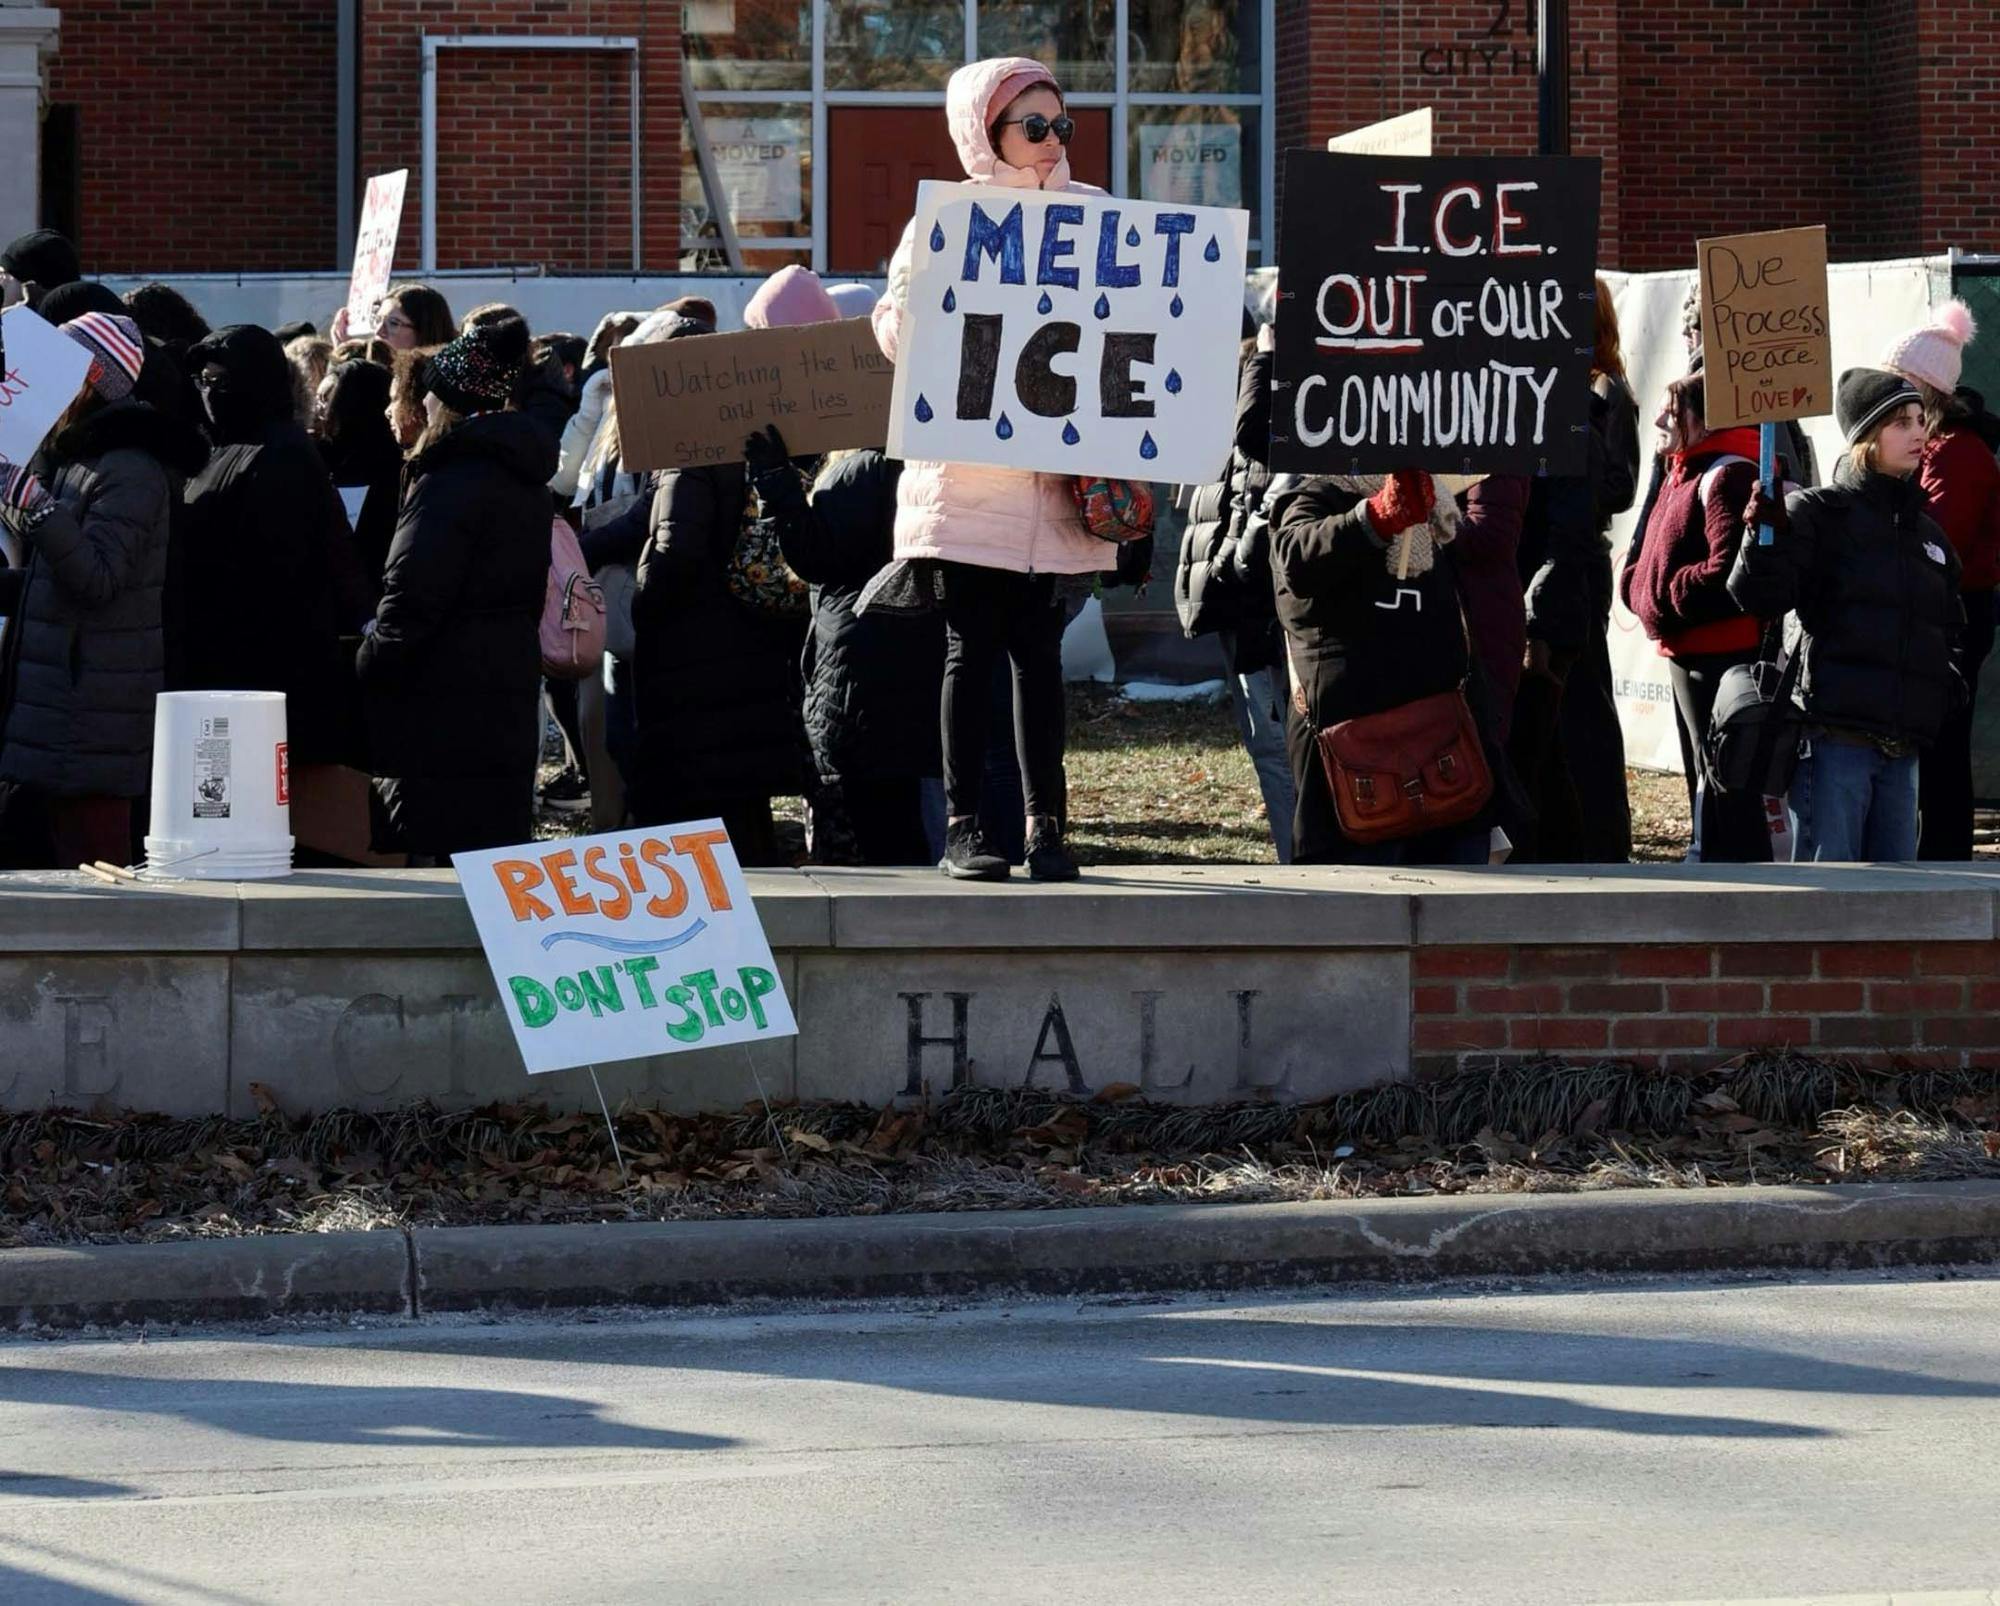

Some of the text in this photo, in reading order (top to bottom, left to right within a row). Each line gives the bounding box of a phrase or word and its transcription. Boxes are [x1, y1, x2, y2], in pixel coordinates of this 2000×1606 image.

[1419, 48, 1601, 76] CITY HL
[1152, 147, 1227, 163] MOVED
[961, 201, 1197, 291] MELT
[1373, 181, 1558, 257] I.C.E.
[1315, 270, 1572, 340] OUT OF OUR
[1707, 246, 1797, 305] Due
[652, 356, 781, 398] Watching
[799, 350, 837, 377] the
[956, 313, 1158, 420] ICE
[719, 403, 753, 422] and
[767, 396, 800, 415] the
[811, 389, 848, 411] lies
[1294, 359, 1559, 448] COMMUNITY
[1734, 385, 1789, 420] LOVE
[1614, 678, 1672, 704] LEINGERS
[507, 955, 660, 1028] DON'T
[897, 990, 1297, 1097] HALL
